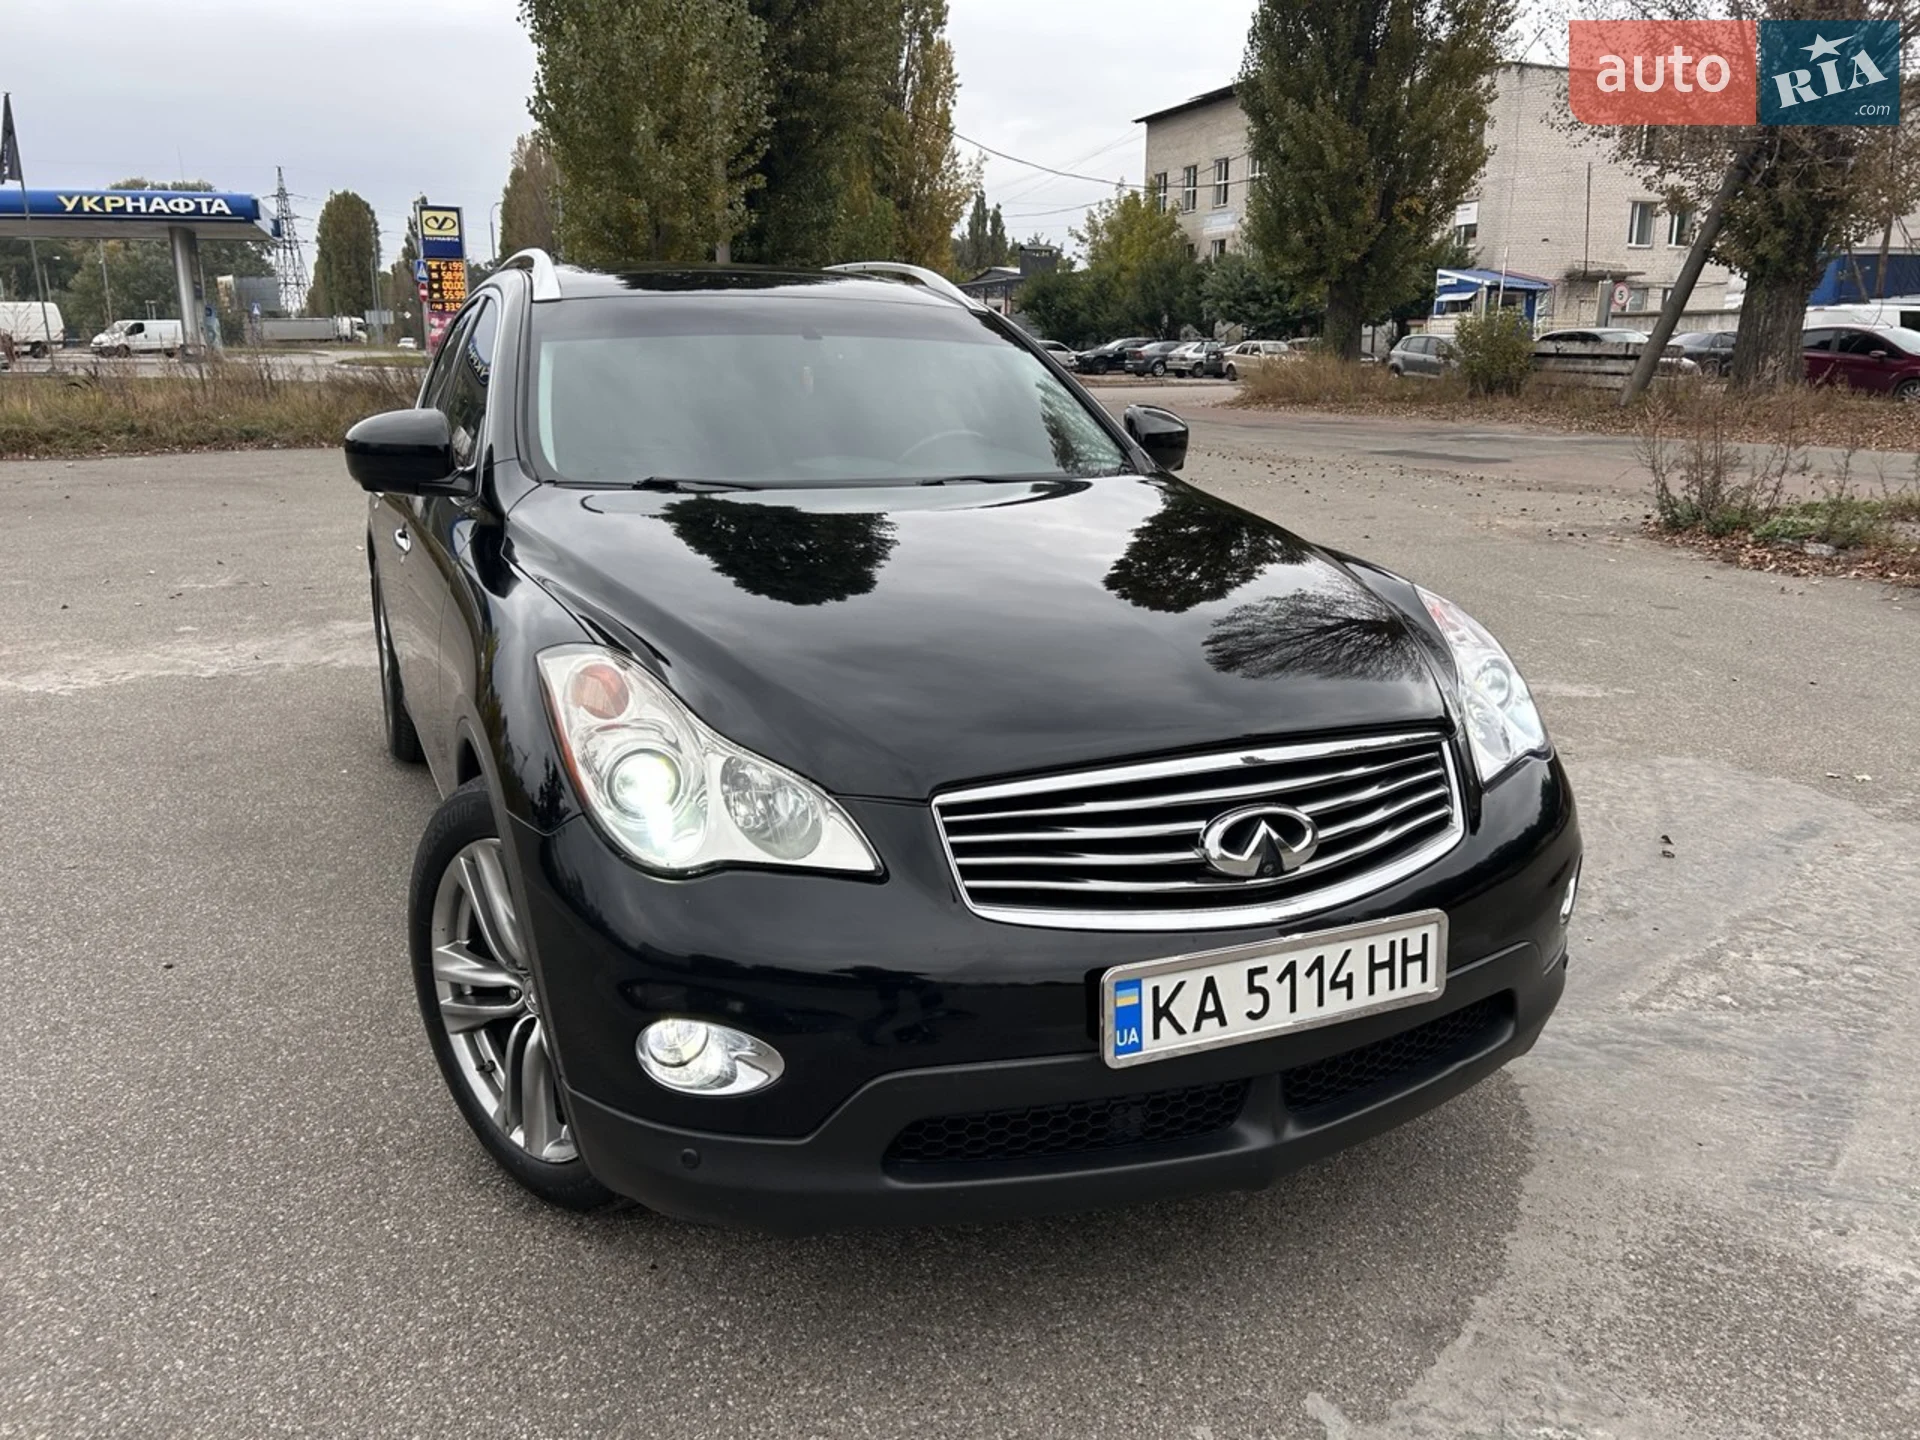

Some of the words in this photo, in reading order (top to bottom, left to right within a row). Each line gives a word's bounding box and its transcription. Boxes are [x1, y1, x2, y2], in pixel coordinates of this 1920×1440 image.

[57, 194, 232, 216] УКРНАФТА
[1618, 290, 1624, 300] 5
[1151, 975, 1228, 1041] KA
[1245, 948, 1354, 1022] 5114
[1367, 933, 1429, 997] HH
[1116, 1027, 1140, 1047] UA
